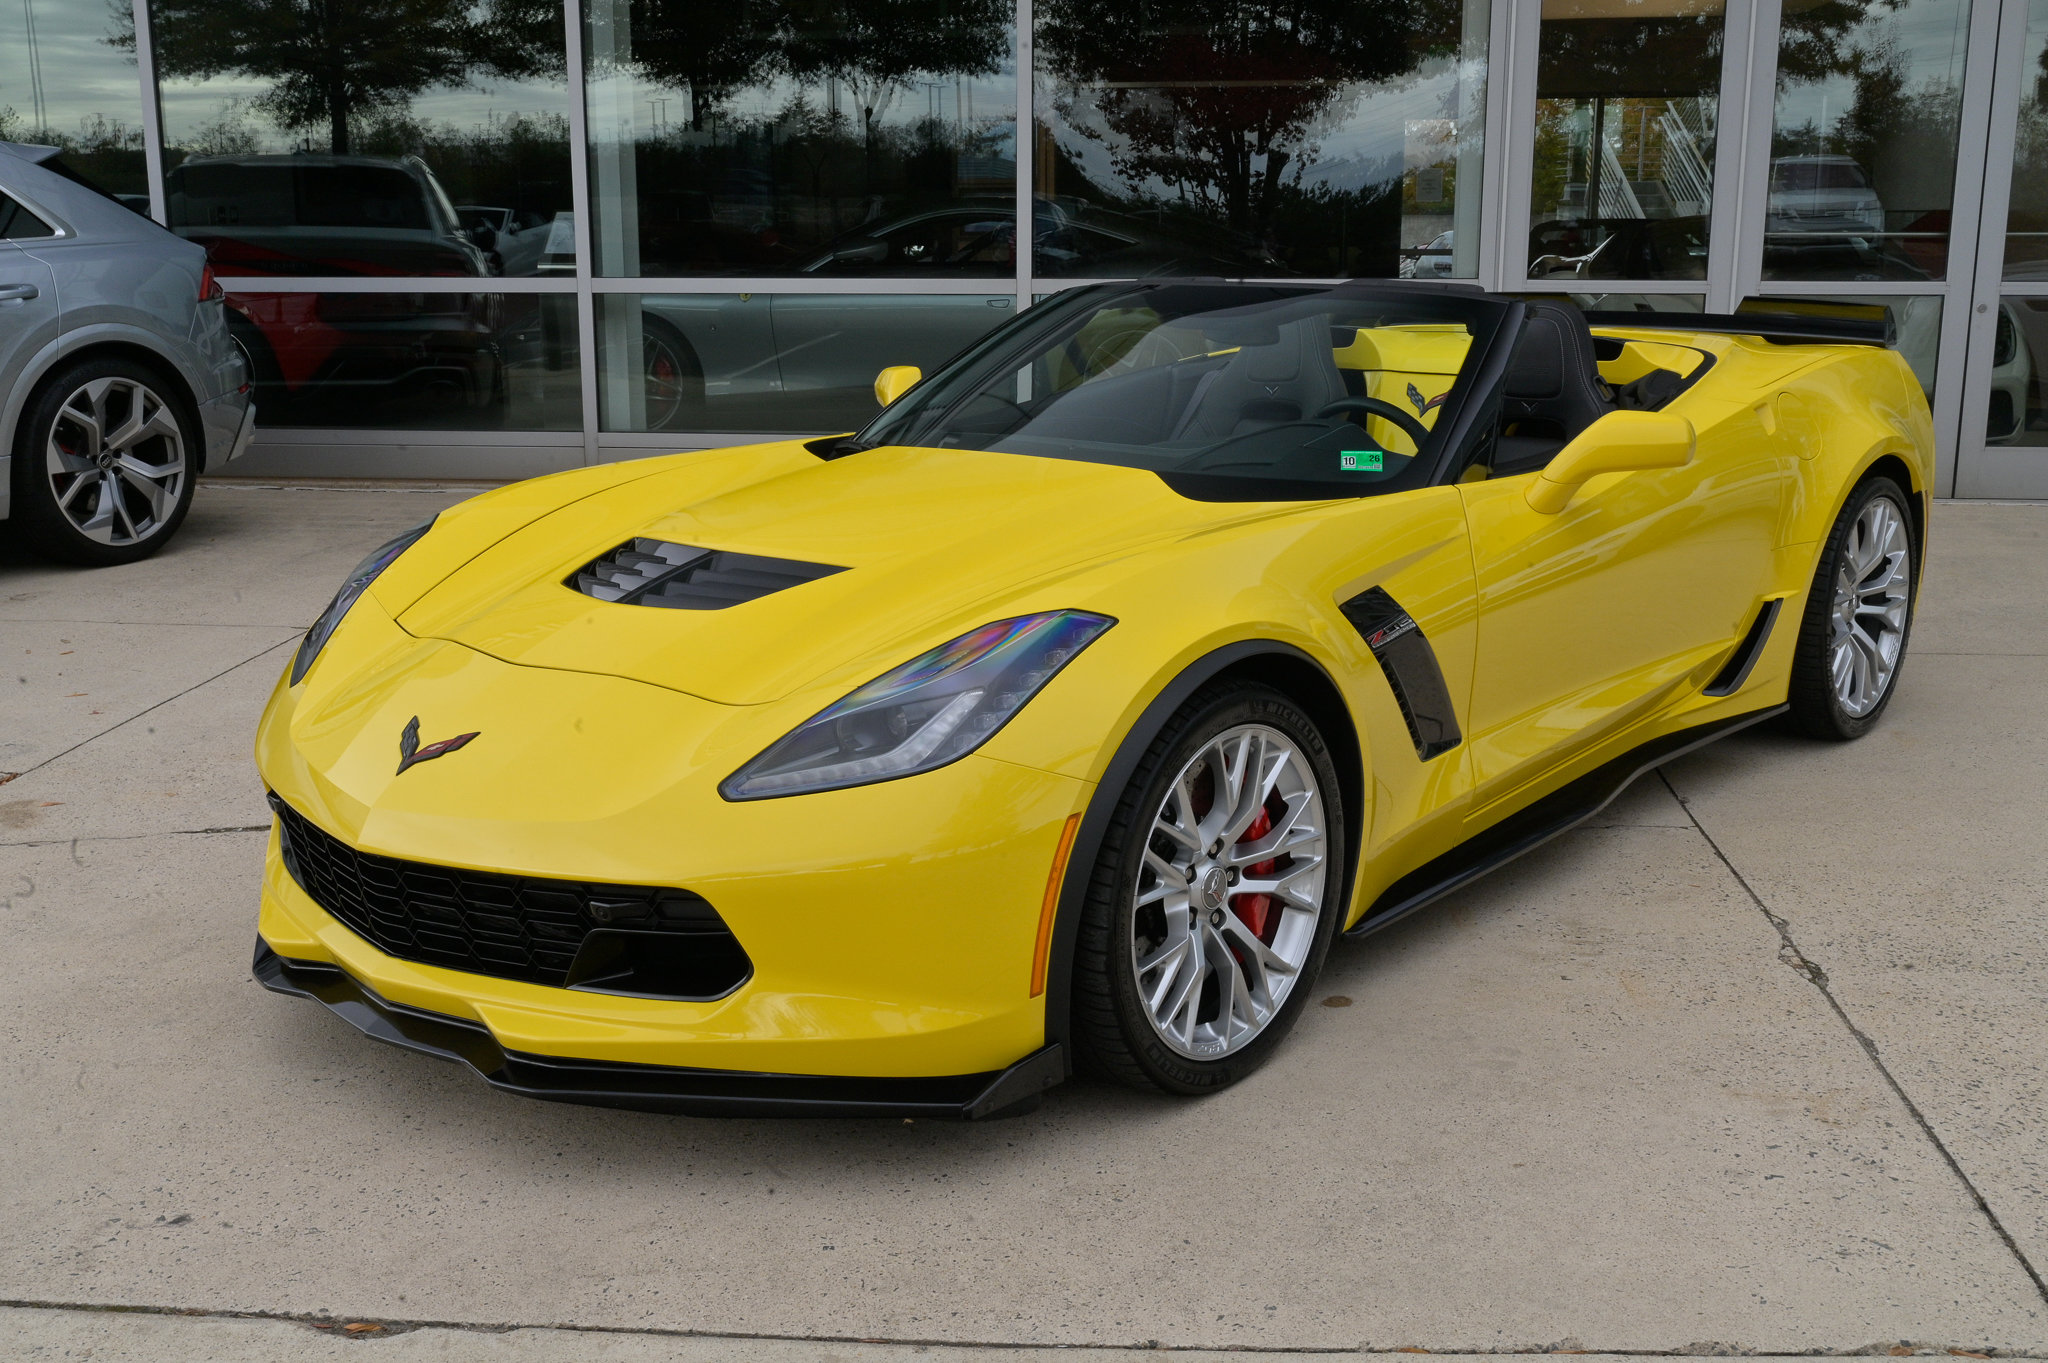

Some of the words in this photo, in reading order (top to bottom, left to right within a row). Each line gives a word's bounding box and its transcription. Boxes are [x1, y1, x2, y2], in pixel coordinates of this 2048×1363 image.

[1343, 457, 1355, 465] 10
[1369, 455, 1380, 463] 26
[1266, 702, 1322, 752] MICHELIN
[1149, 1047, 1212, 1086] MICHELIN
